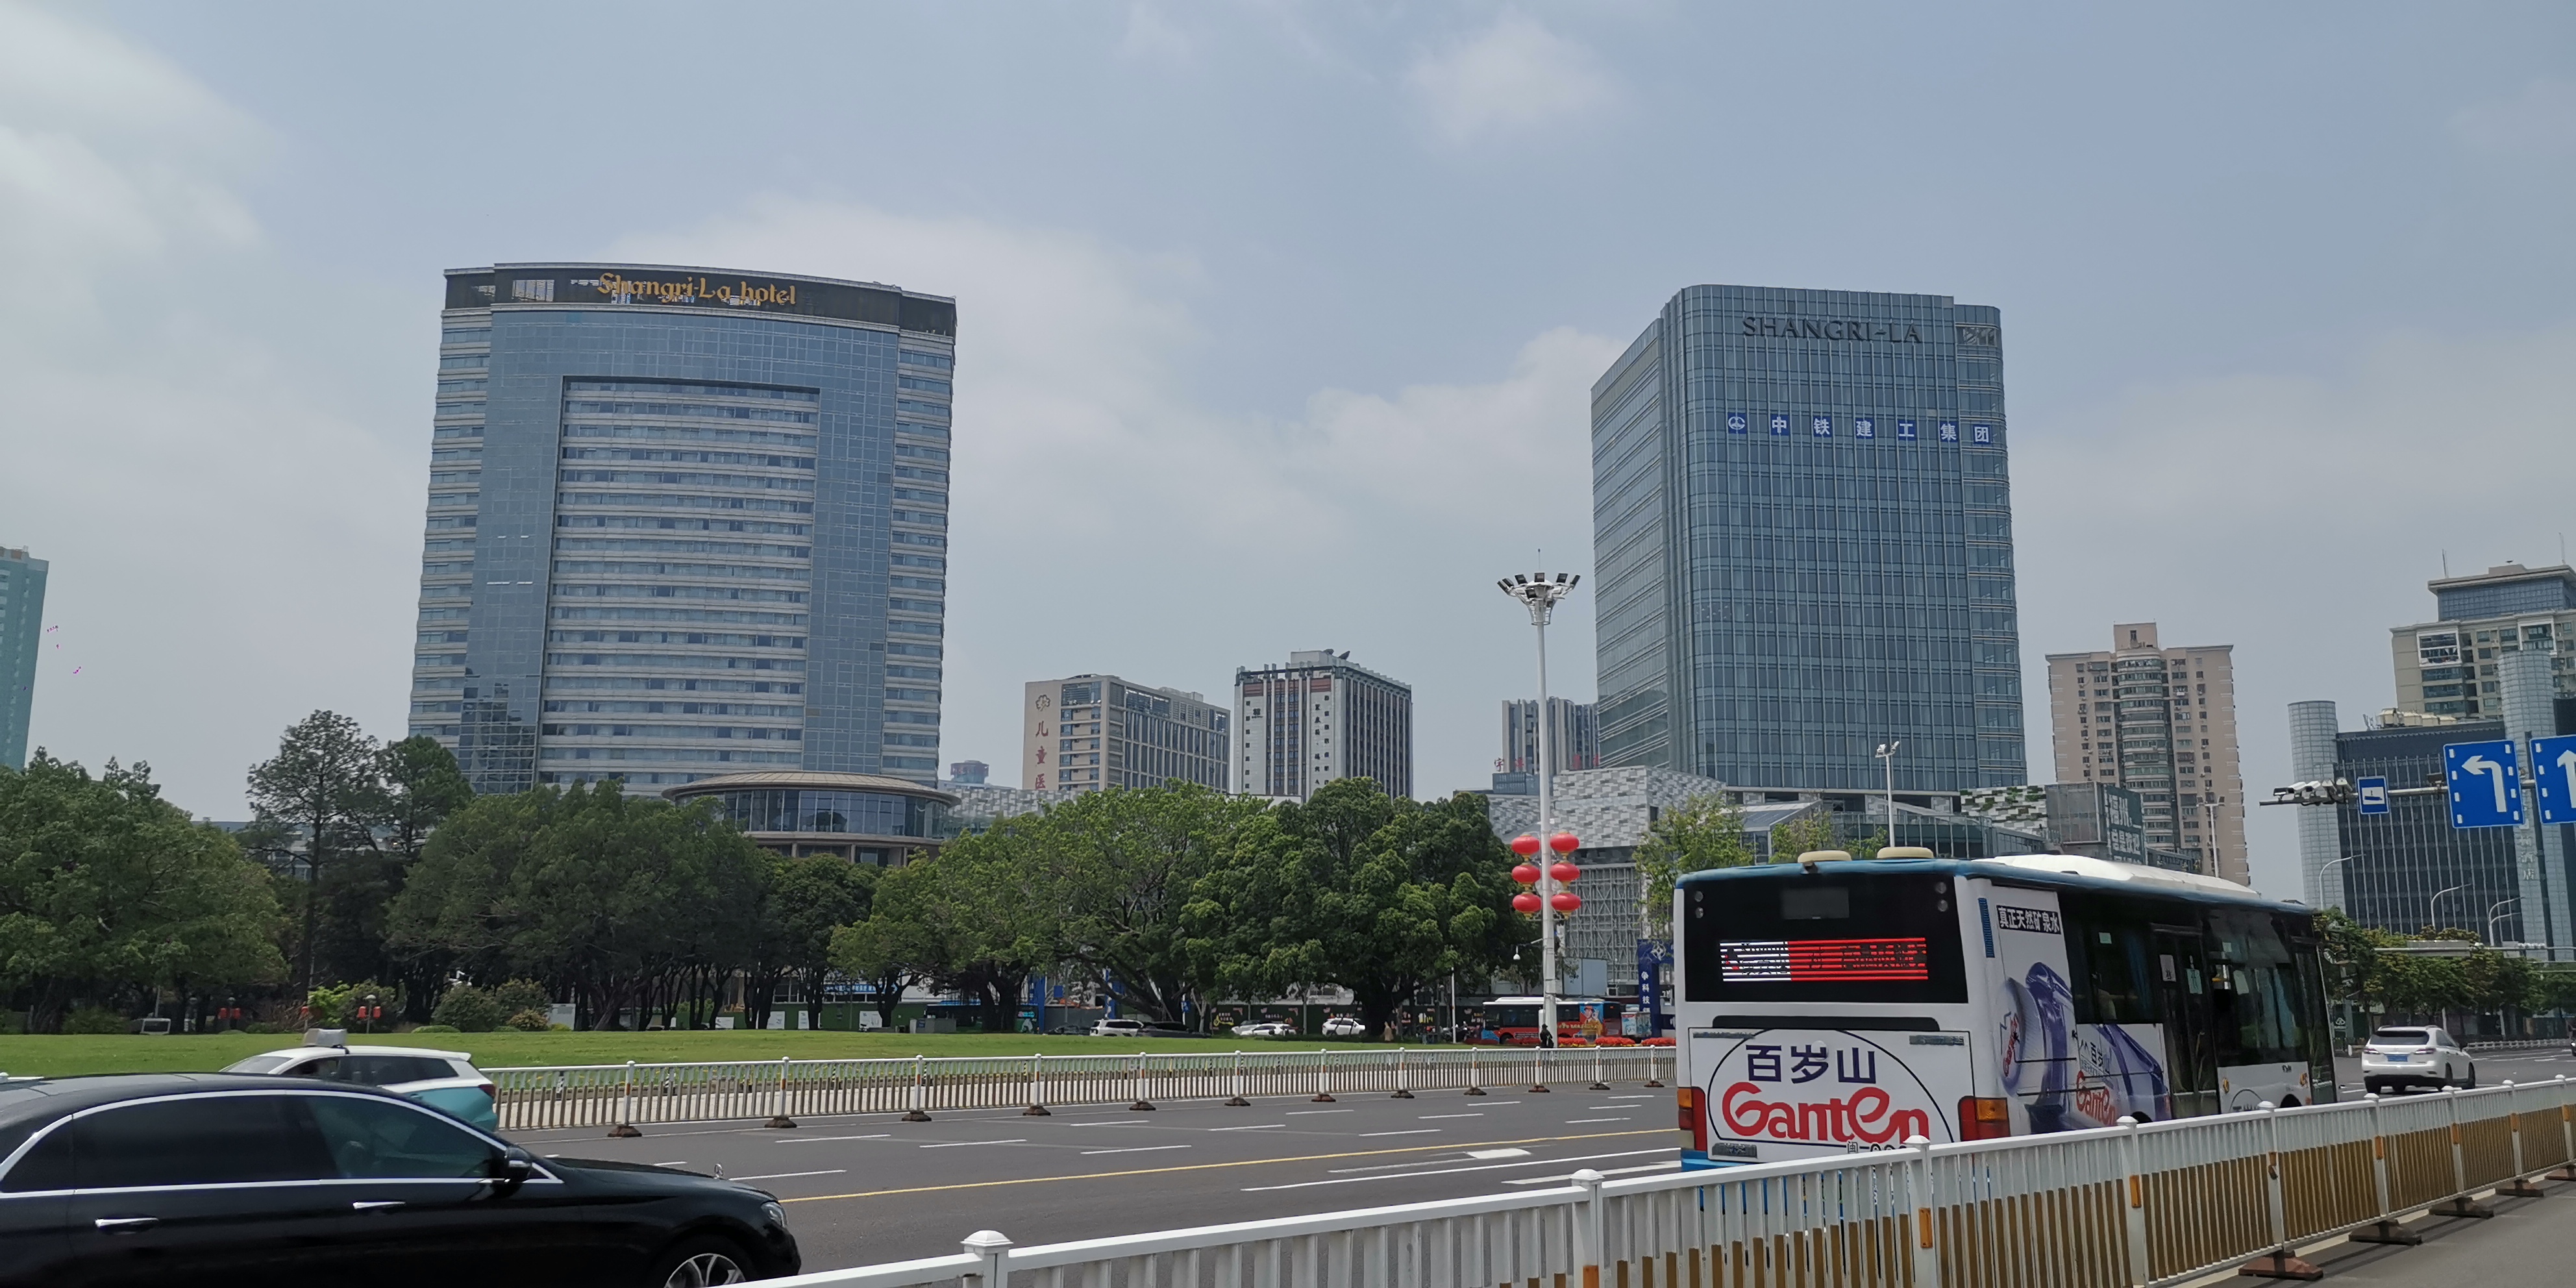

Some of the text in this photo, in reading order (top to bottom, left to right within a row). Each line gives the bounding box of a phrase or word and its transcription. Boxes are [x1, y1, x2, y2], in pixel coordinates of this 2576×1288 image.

[597, 272, 796, 304] Shangri-La hotel
[1742, 317, 1922, 343] SHANGRI-LA
[1771, 416, 1990, 443] 中铁建工集团
[1998, 906, 2061, 933] 真正天然矿泉水
[1746, 1044, 1876, 1084] 百岁山
